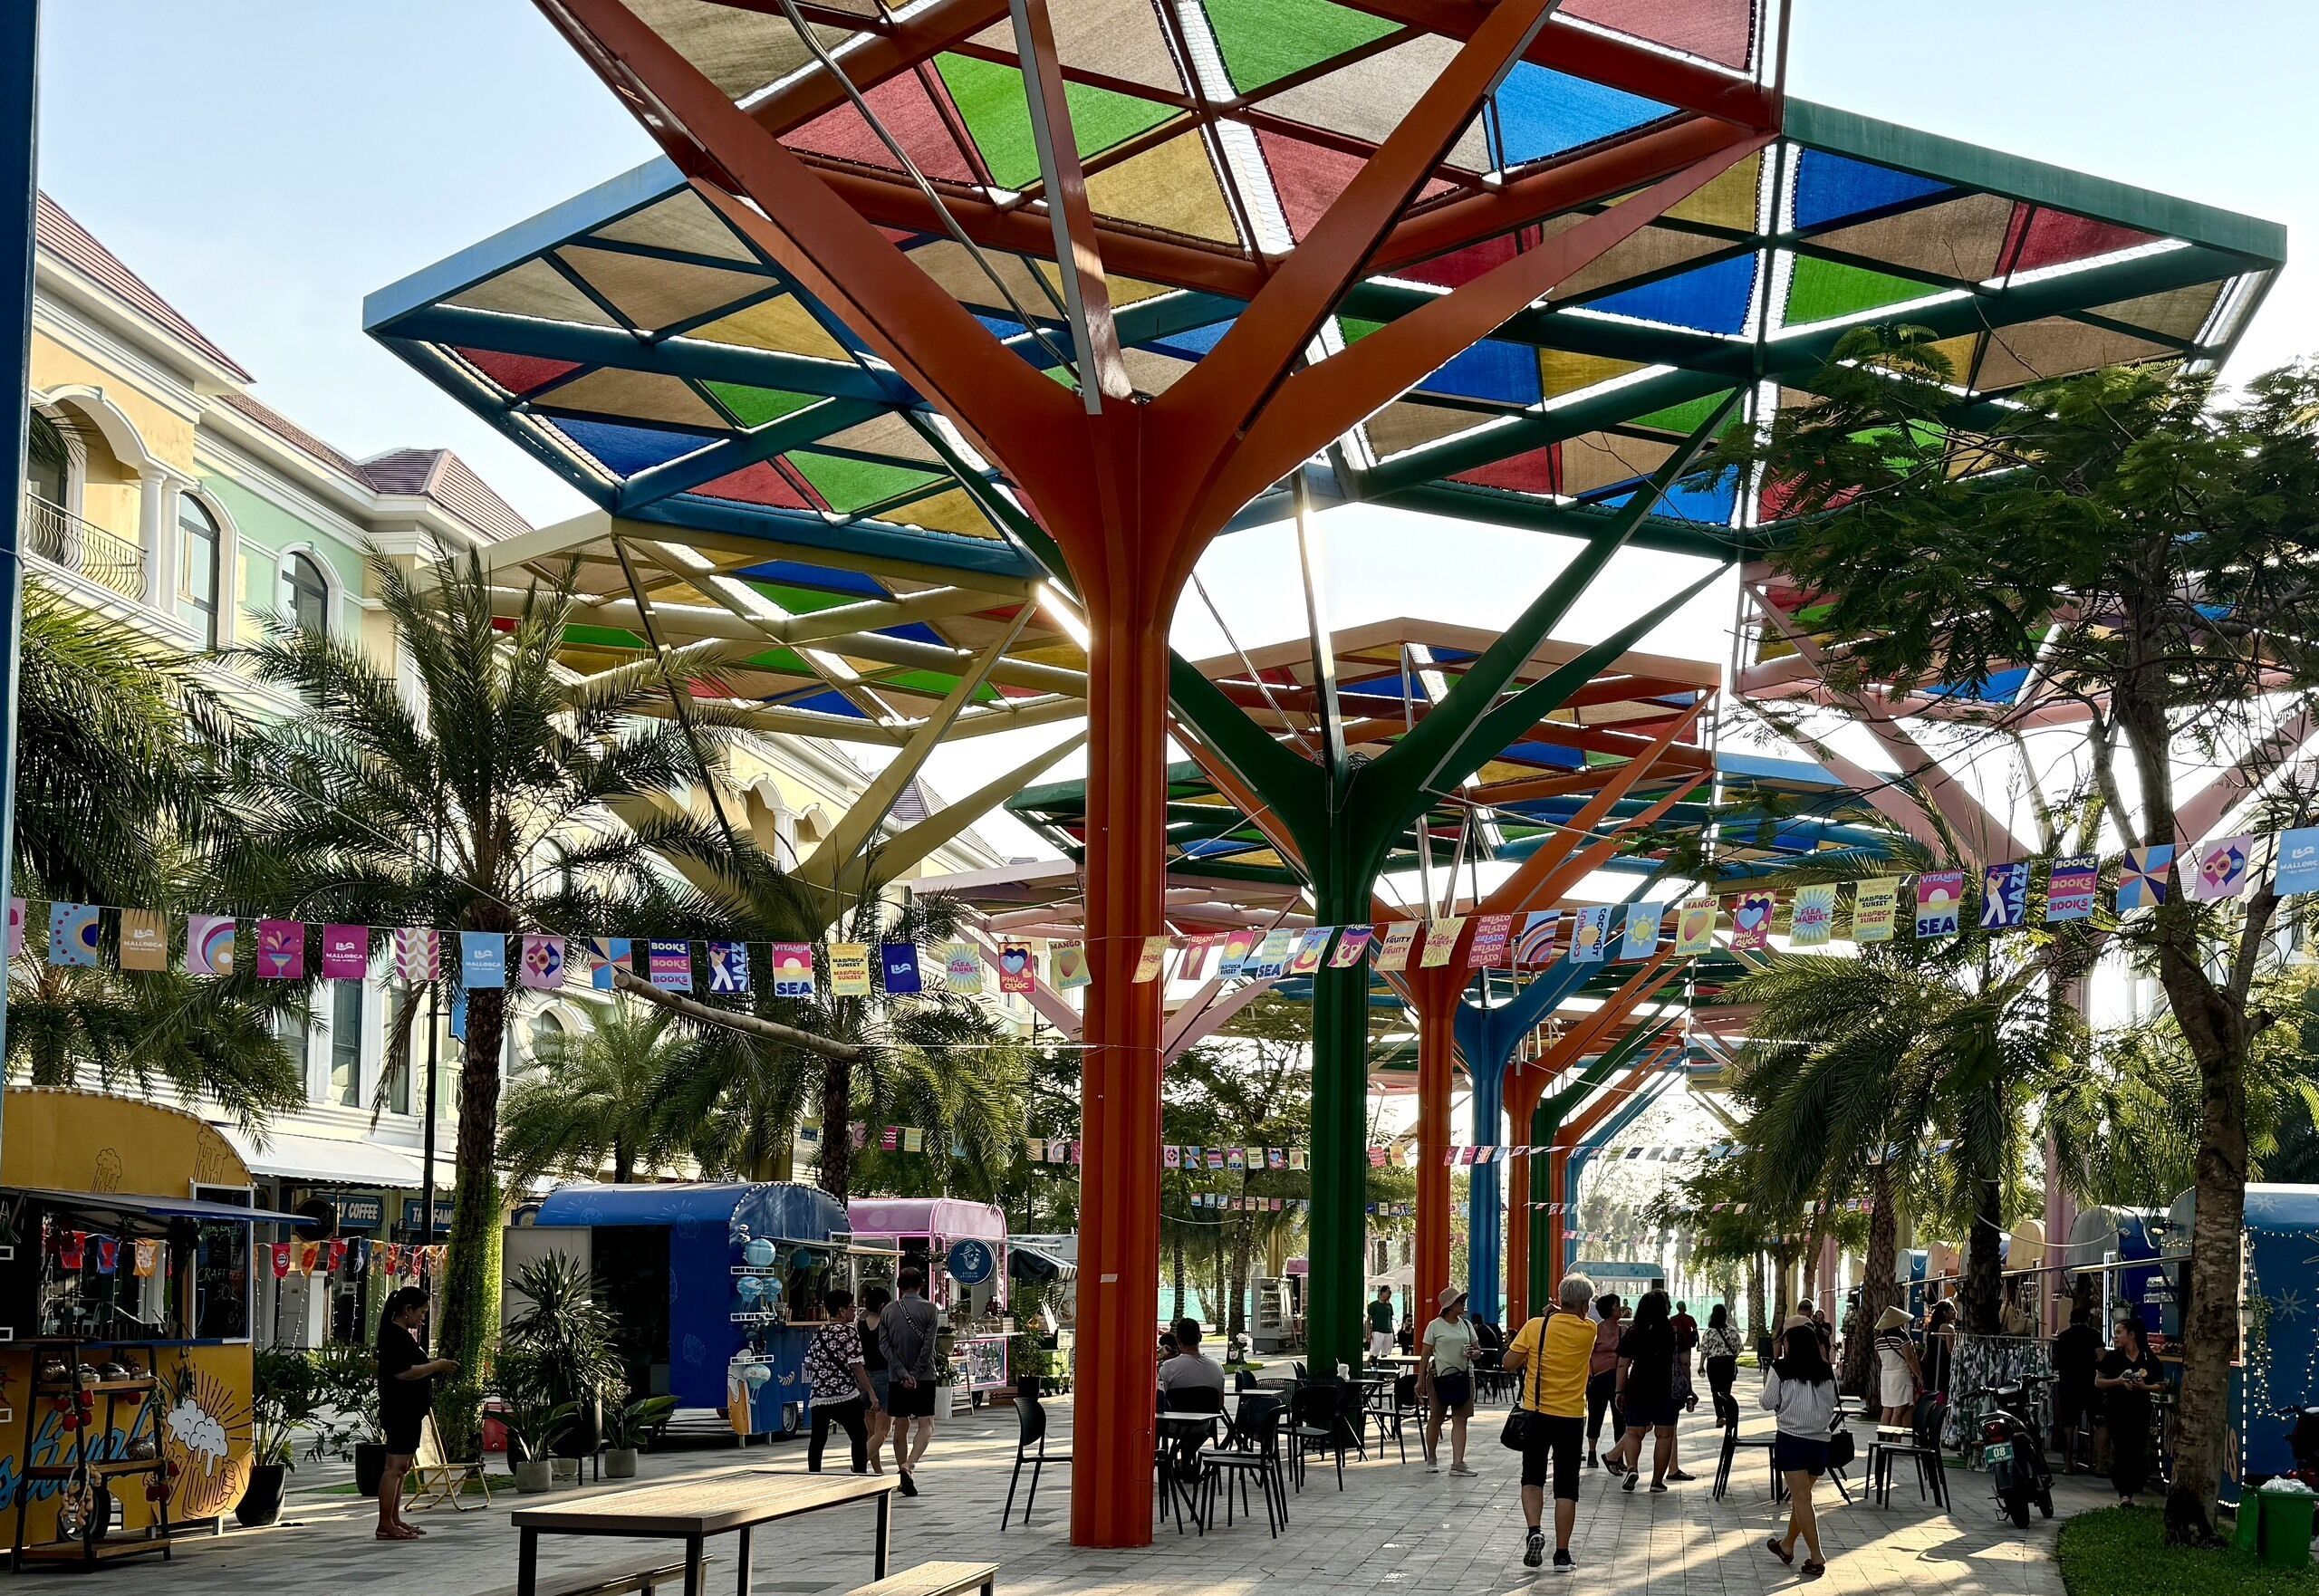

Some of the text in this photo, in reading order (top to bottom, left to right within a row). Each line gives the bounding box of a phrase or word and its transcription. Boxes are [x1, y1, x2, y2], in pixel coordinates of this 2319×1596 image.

[2054, 857, 2095, 870] BOOKS
[2280, 860, 2319, 870] MALLORC
[1921, 873, 1962, 883] VITAMIN
[2051, 877, 2092, 889] BOOKS
[2007, 862, 2029, 924] JAZZ
[1685, 898, 1717, 909] MANGO
[2049, 899, 2088, 911] BOOKS
[1800, 906, 1822, 916] FLEA
[1481, 915, 1511, 924] GELATO
[1795, 913, 1829, 924] MARKET
[1860, 916, 1886, 924] SUNSET
[1478, 925, 1507, 934] GELATO
[1917, 917, 1956, 936] SEA
[123, 940, 162, 948] MALLORCA
[1051, 940, 1081, 949] MANGO
[1385, 935, 1411, 944] FRUITY
[1475, 935, 1505, 944] GELATO
[650, 942, 687, 954] BOOKS
[1382, 946, 1408, 955] FRUITY
[1472, 944, 1502, 954] GELATO
[1470, 954, 1499, 964] GELATO
[651, 959, 688, 970] BOOKS
[730, 941, 748, 992] JAZZ
[1257, 964, 1281, 977] SEA
[653, 976, 688, 985] BOOKS
[775, 982, 813, 995] SEA
[348, 1202, 379, 1220] COFFEE
[1993, 1447, 2006, 1457] 08
